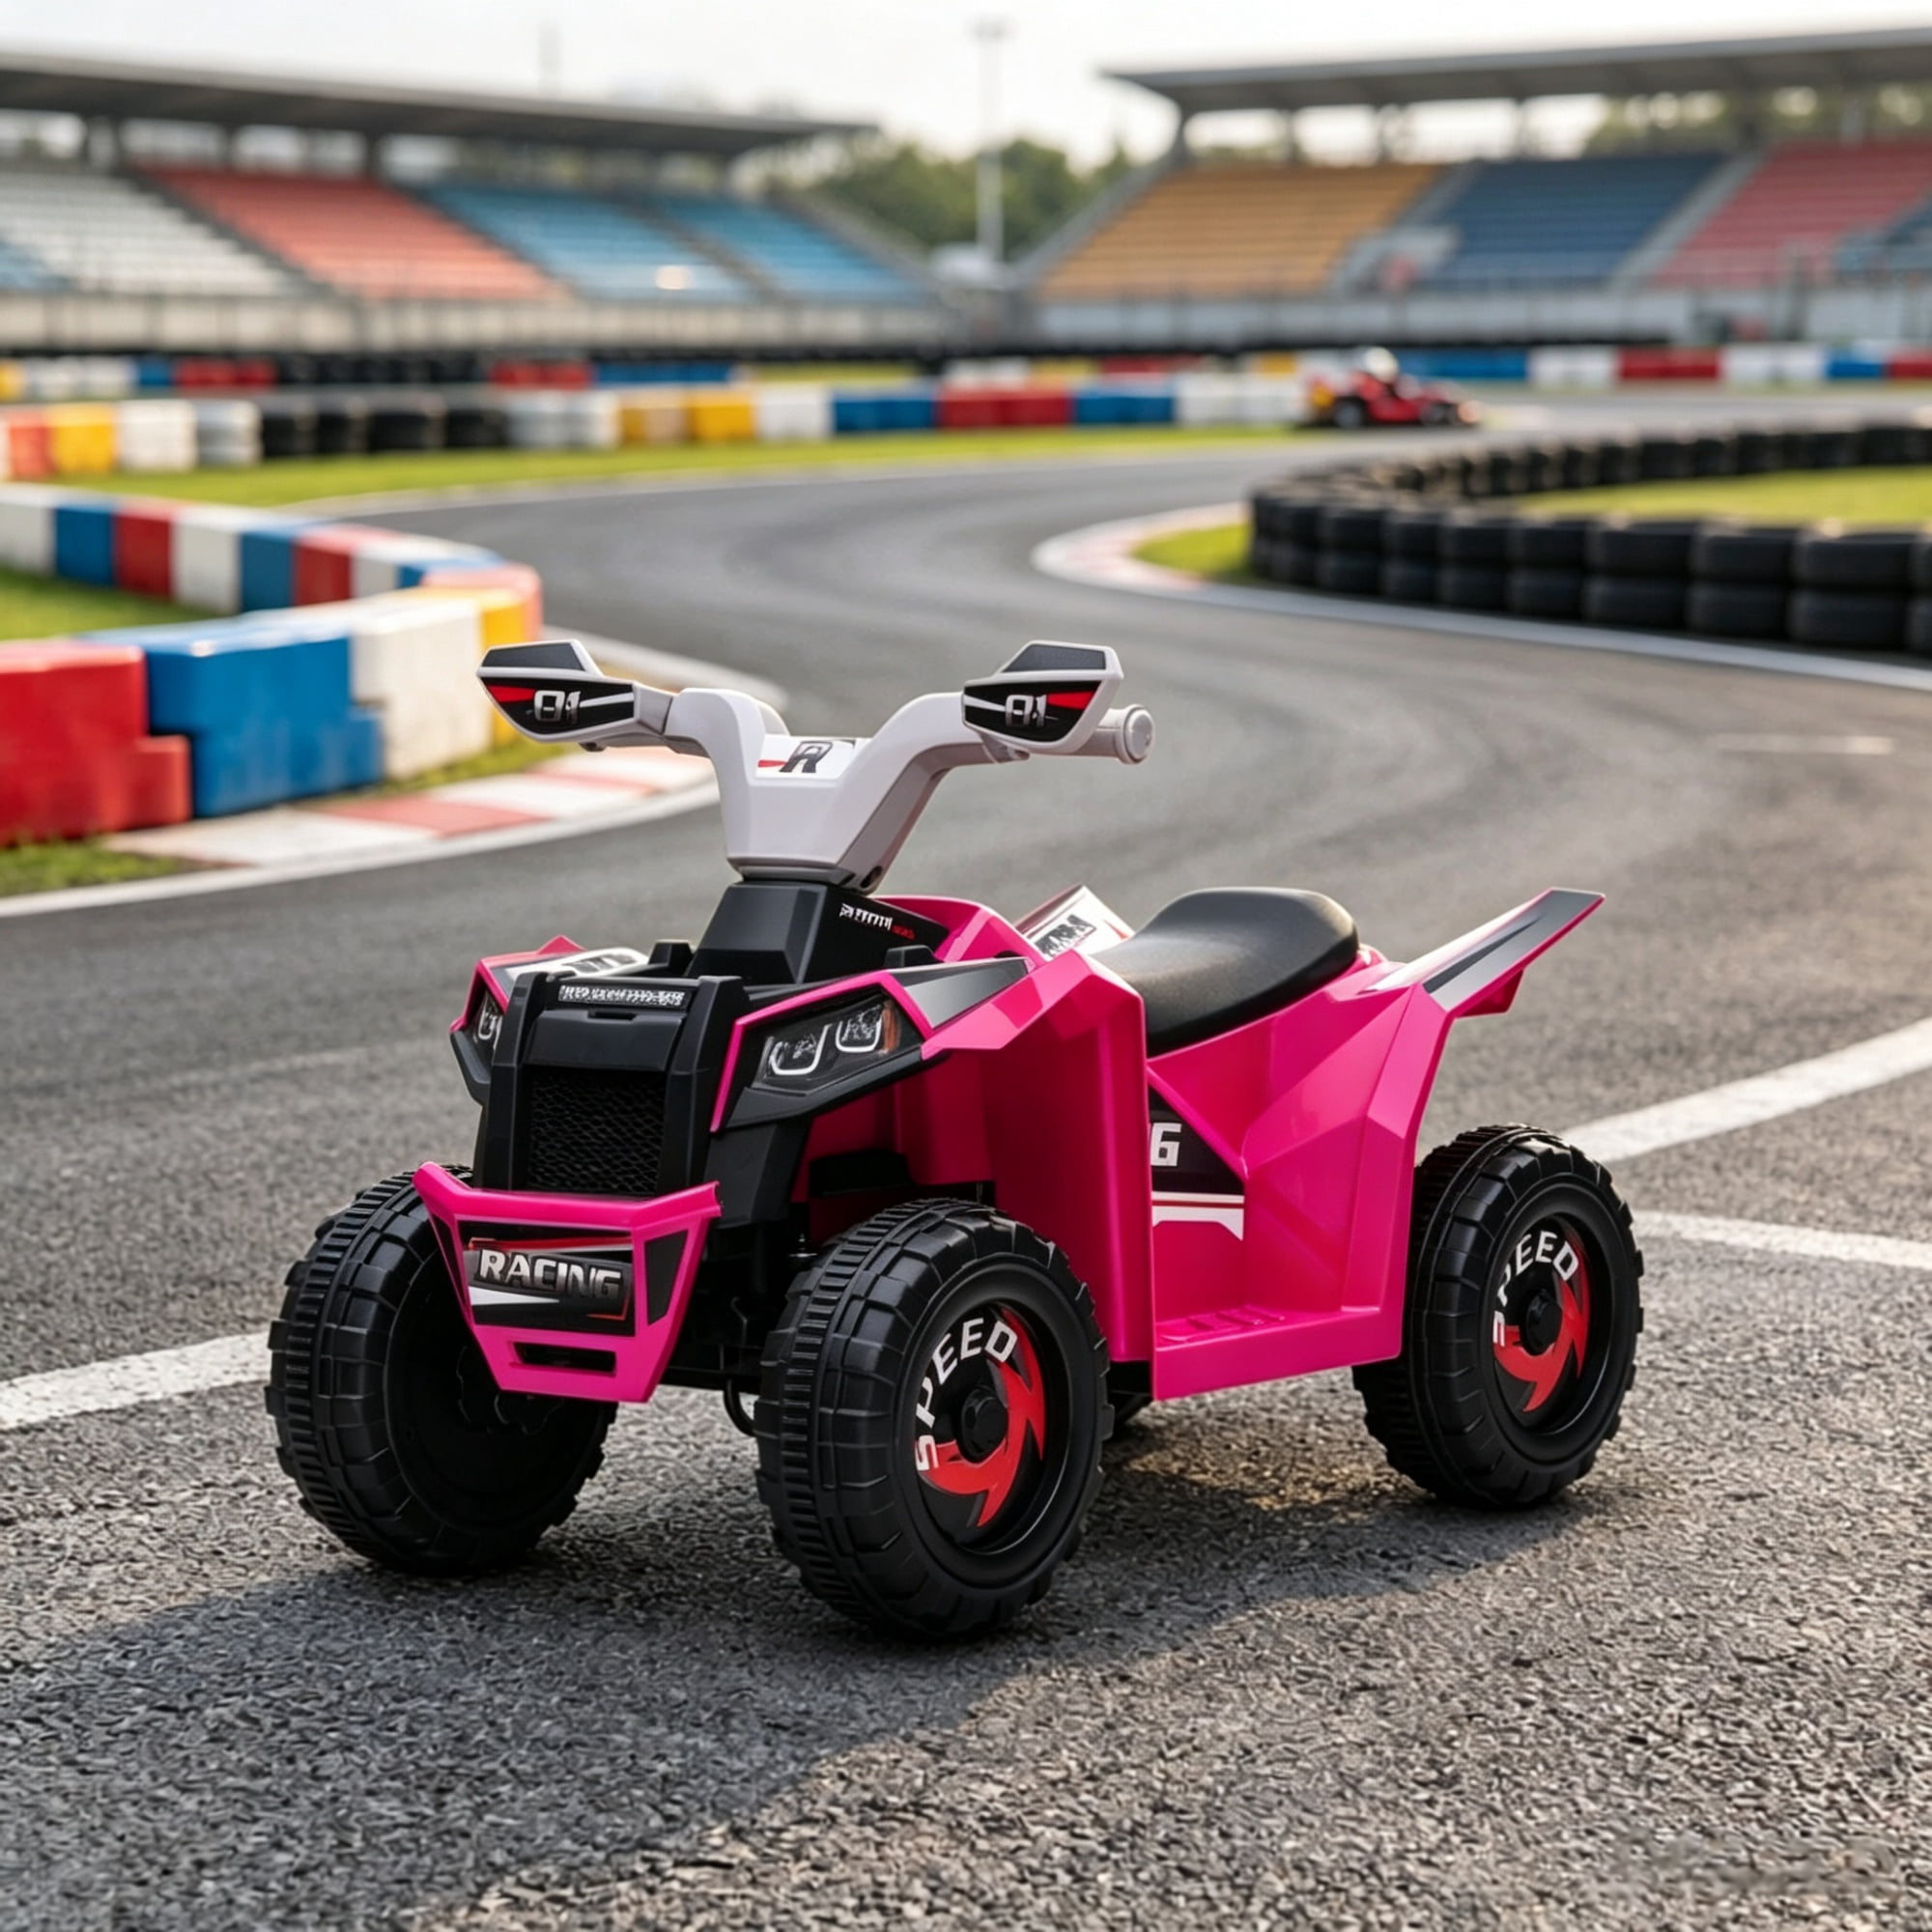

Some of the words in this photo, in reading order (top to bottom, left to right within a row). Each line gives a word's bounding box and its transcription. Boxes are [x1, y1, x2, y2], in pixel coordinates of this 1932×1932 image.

[779, 740, 834, 774] R
[1151, 1122, 1182, 1167] 6
[479, 1248, 622, 1299] RACING
[915, 1317, 1018, 1471] SPEED
